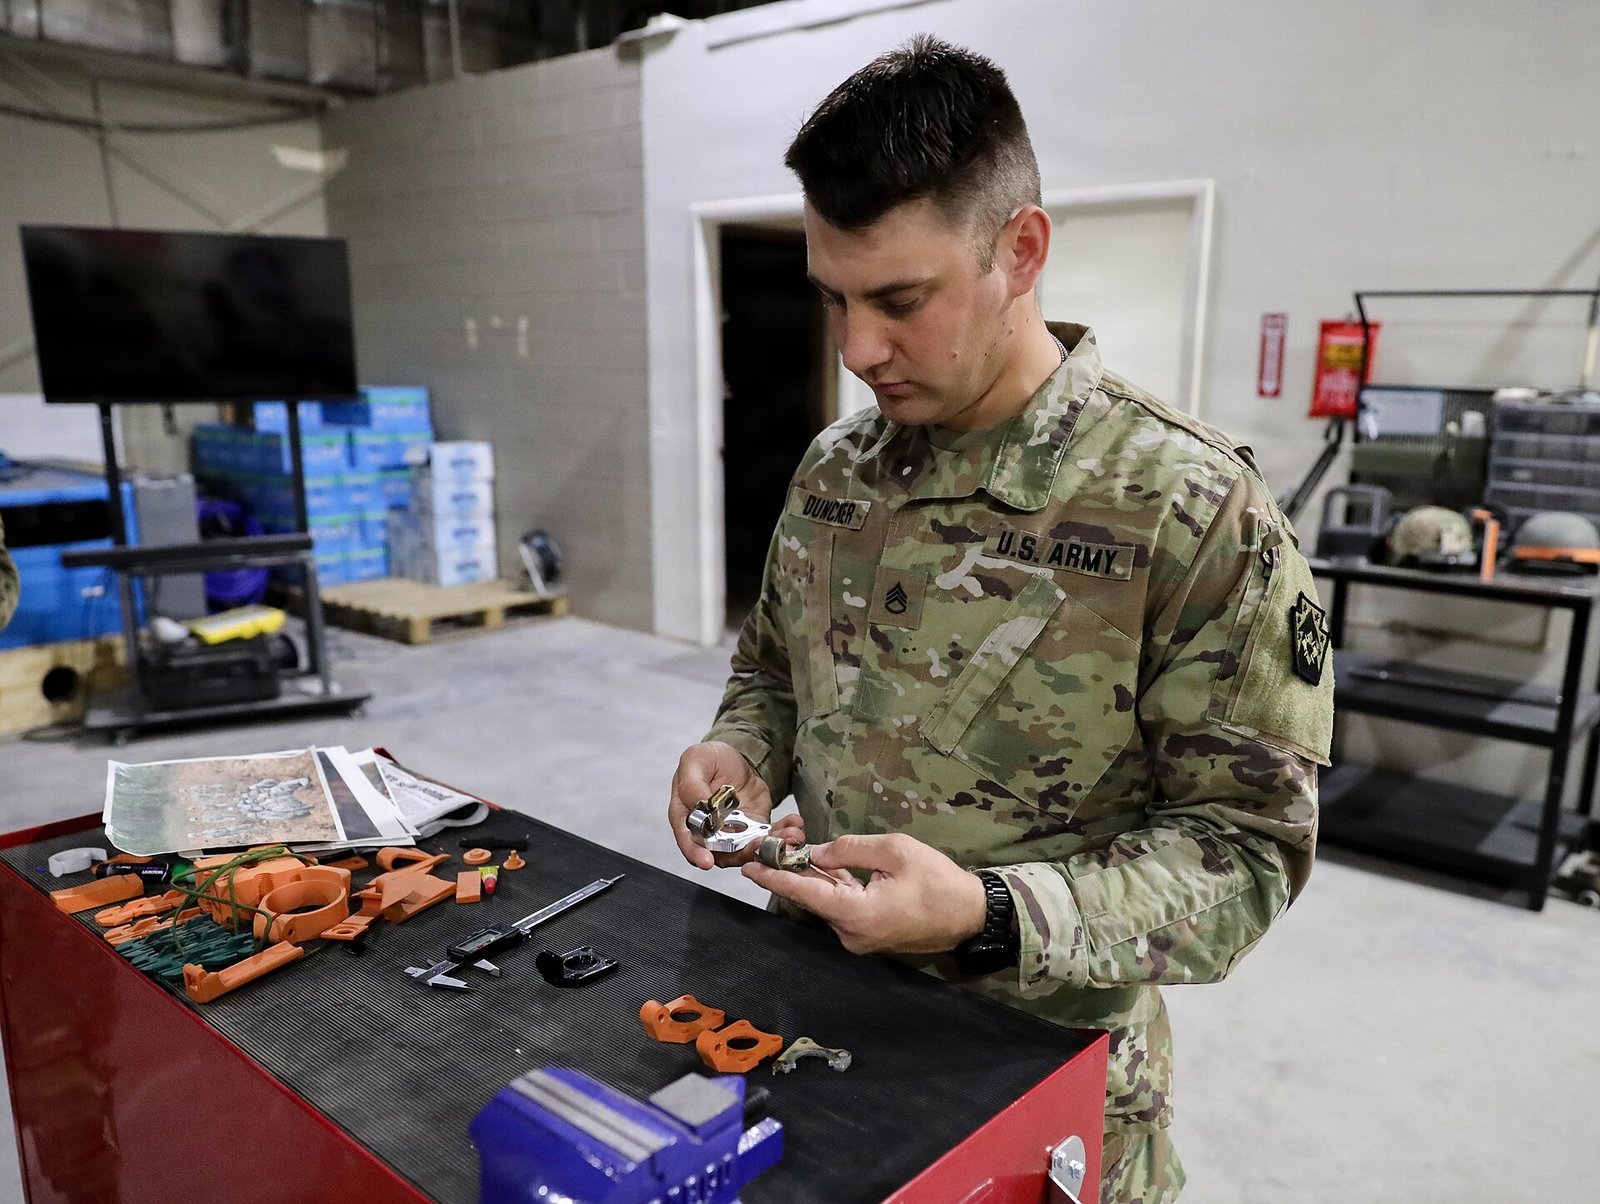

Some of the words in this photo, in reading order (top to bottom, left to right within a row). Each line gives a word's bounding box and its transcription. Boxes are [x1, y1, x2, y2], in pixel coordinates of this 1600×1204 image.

[803, 495, 856, 525] DUNCKER
[997, 531, 1039, 562] U.S.
[1048, 542, 1118, 574] ARMY
